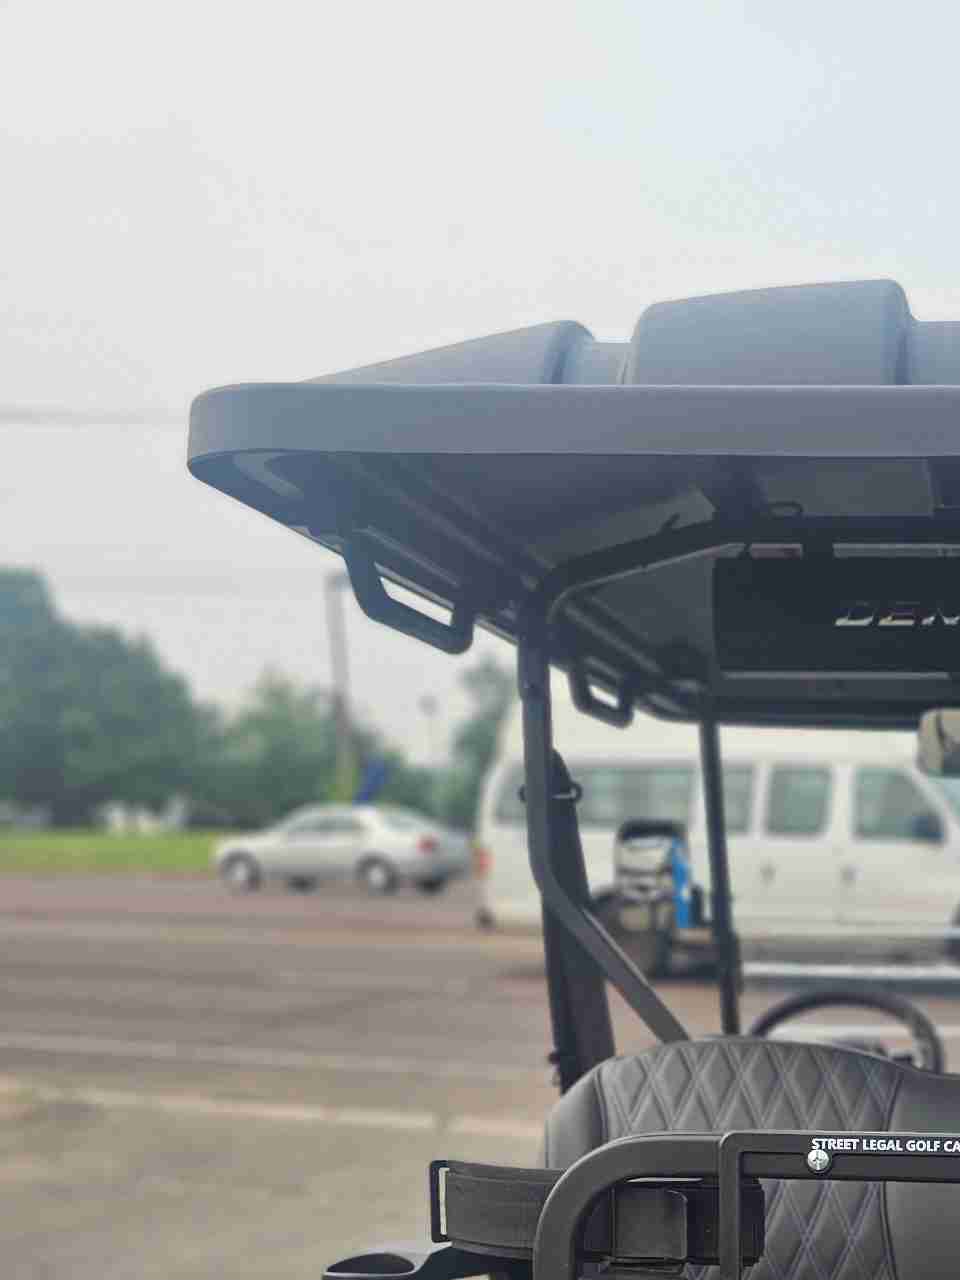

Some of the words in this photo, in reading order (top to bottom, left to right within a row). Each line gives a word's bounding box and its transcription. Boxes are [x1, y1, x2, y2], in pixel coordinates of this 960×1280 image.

[811, 1137, 860, 1151] STREET
[862, 1138, 903, 1152] LEGAL
[905, 1139, 941, 1153] GOLF
